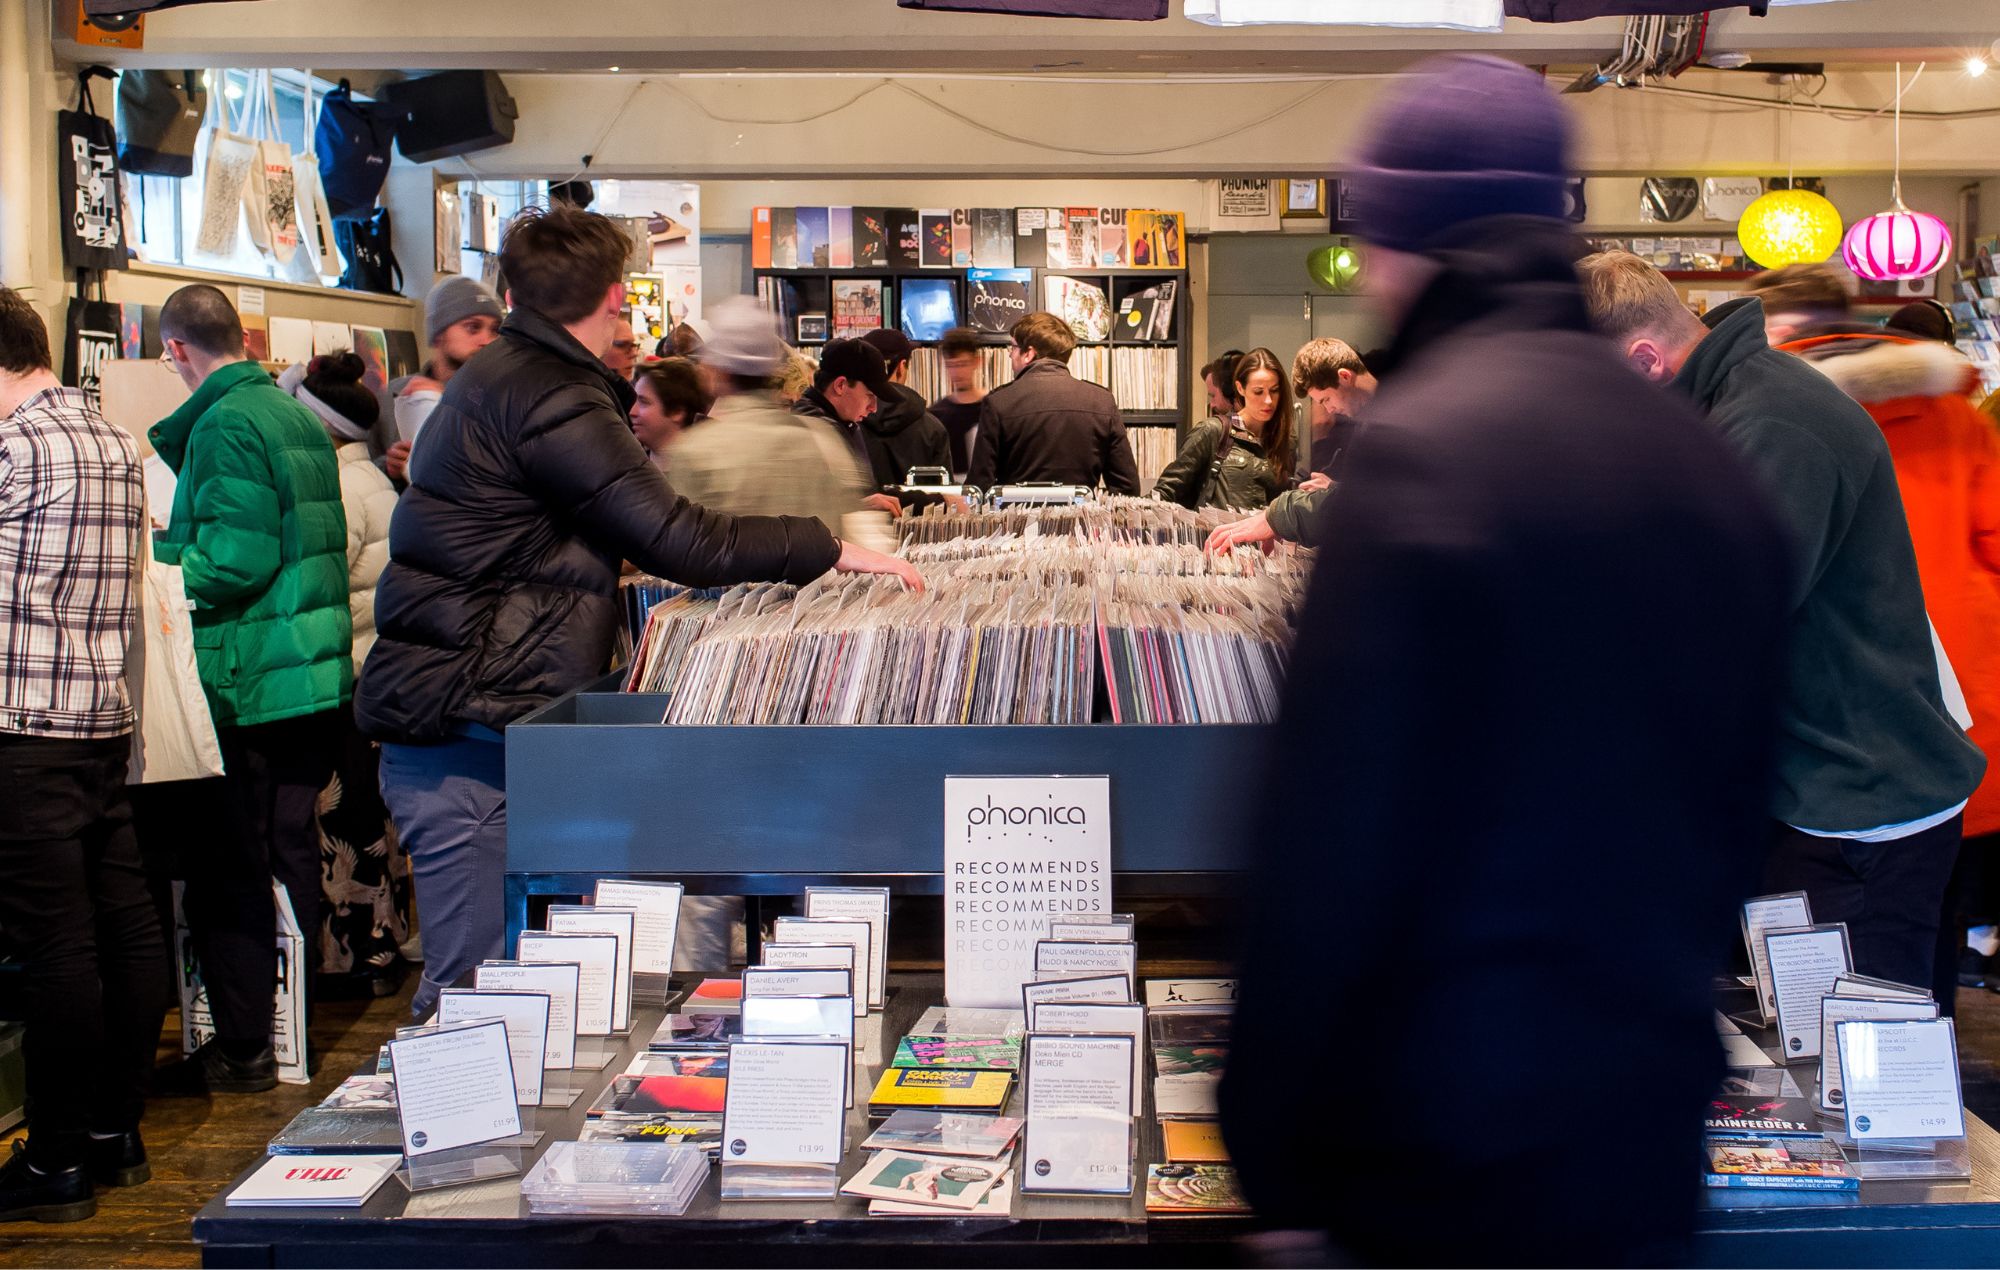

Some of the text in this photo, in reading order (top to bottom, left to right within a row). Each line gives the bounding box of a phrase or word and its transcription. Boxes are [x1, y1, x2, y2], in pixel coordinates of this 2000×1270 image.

[974, 290, 1026, 310] phonica
[968, 795, 1086, 840] phonica
[955, 861, 1100, 875] RECOMMENDS
[955, 879, 1100, 894] RECOMMENDS
[956, 898, 1101, 913] RECOMMENDS
[1060, 949, 1106, 957] OAKENFOLD,
[1826, 1004, 1854, 1012] VARIOUS
[1035, 1059, 1064, 1067] MERGE
[1705, 1119, 1808, 1131] RAINFEEDER X
[1921, 1118, 1946, 1126] £14.99
[640, 1125, 701, 1135] FUNK
[799, 1145, 824, 1153] £13.99
[285, 1168, 353, 1180] CHIC
